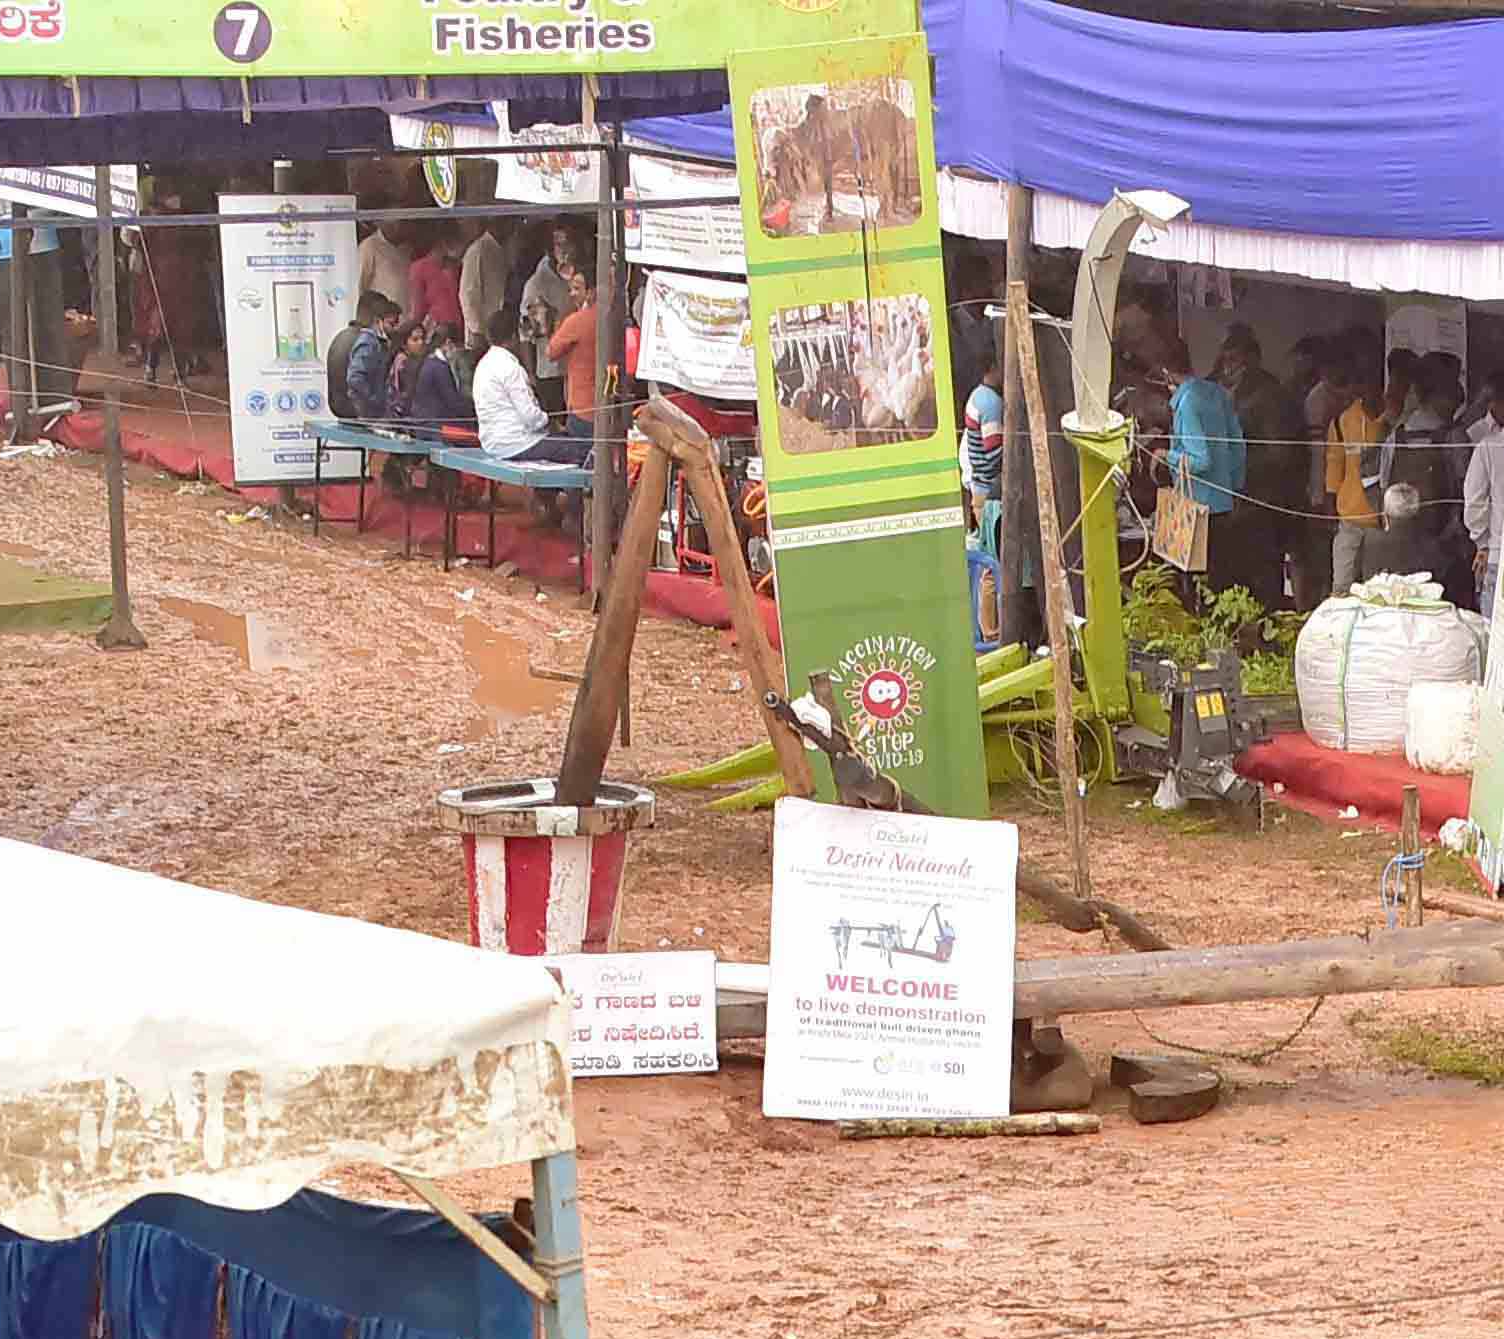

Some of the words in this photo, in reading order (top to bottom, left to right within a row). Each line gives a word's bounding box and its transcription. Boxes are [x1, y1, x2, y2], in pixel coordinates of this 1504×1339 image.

[225, 9, 259, 55] 7
[435, 17, 652, 50] Fisheries
[829, 635, 937, 684] VACCINATION
[865, 732, 914, 754] STOP
[865, 749, 924, 769] OVID-19
[826, 845, 886, 869] Desiri
[888, 852, 974, 880] Naturals
[825, 973, 959, 1001] WELCOME
[796, 997, 813, 1012] to
[819, 997, 850, 1013] live
[855, 1001, 987, 1025] demonstration
[799, 1016, 812, 1025] of
[815, 1017, 878, 1031] traditional
